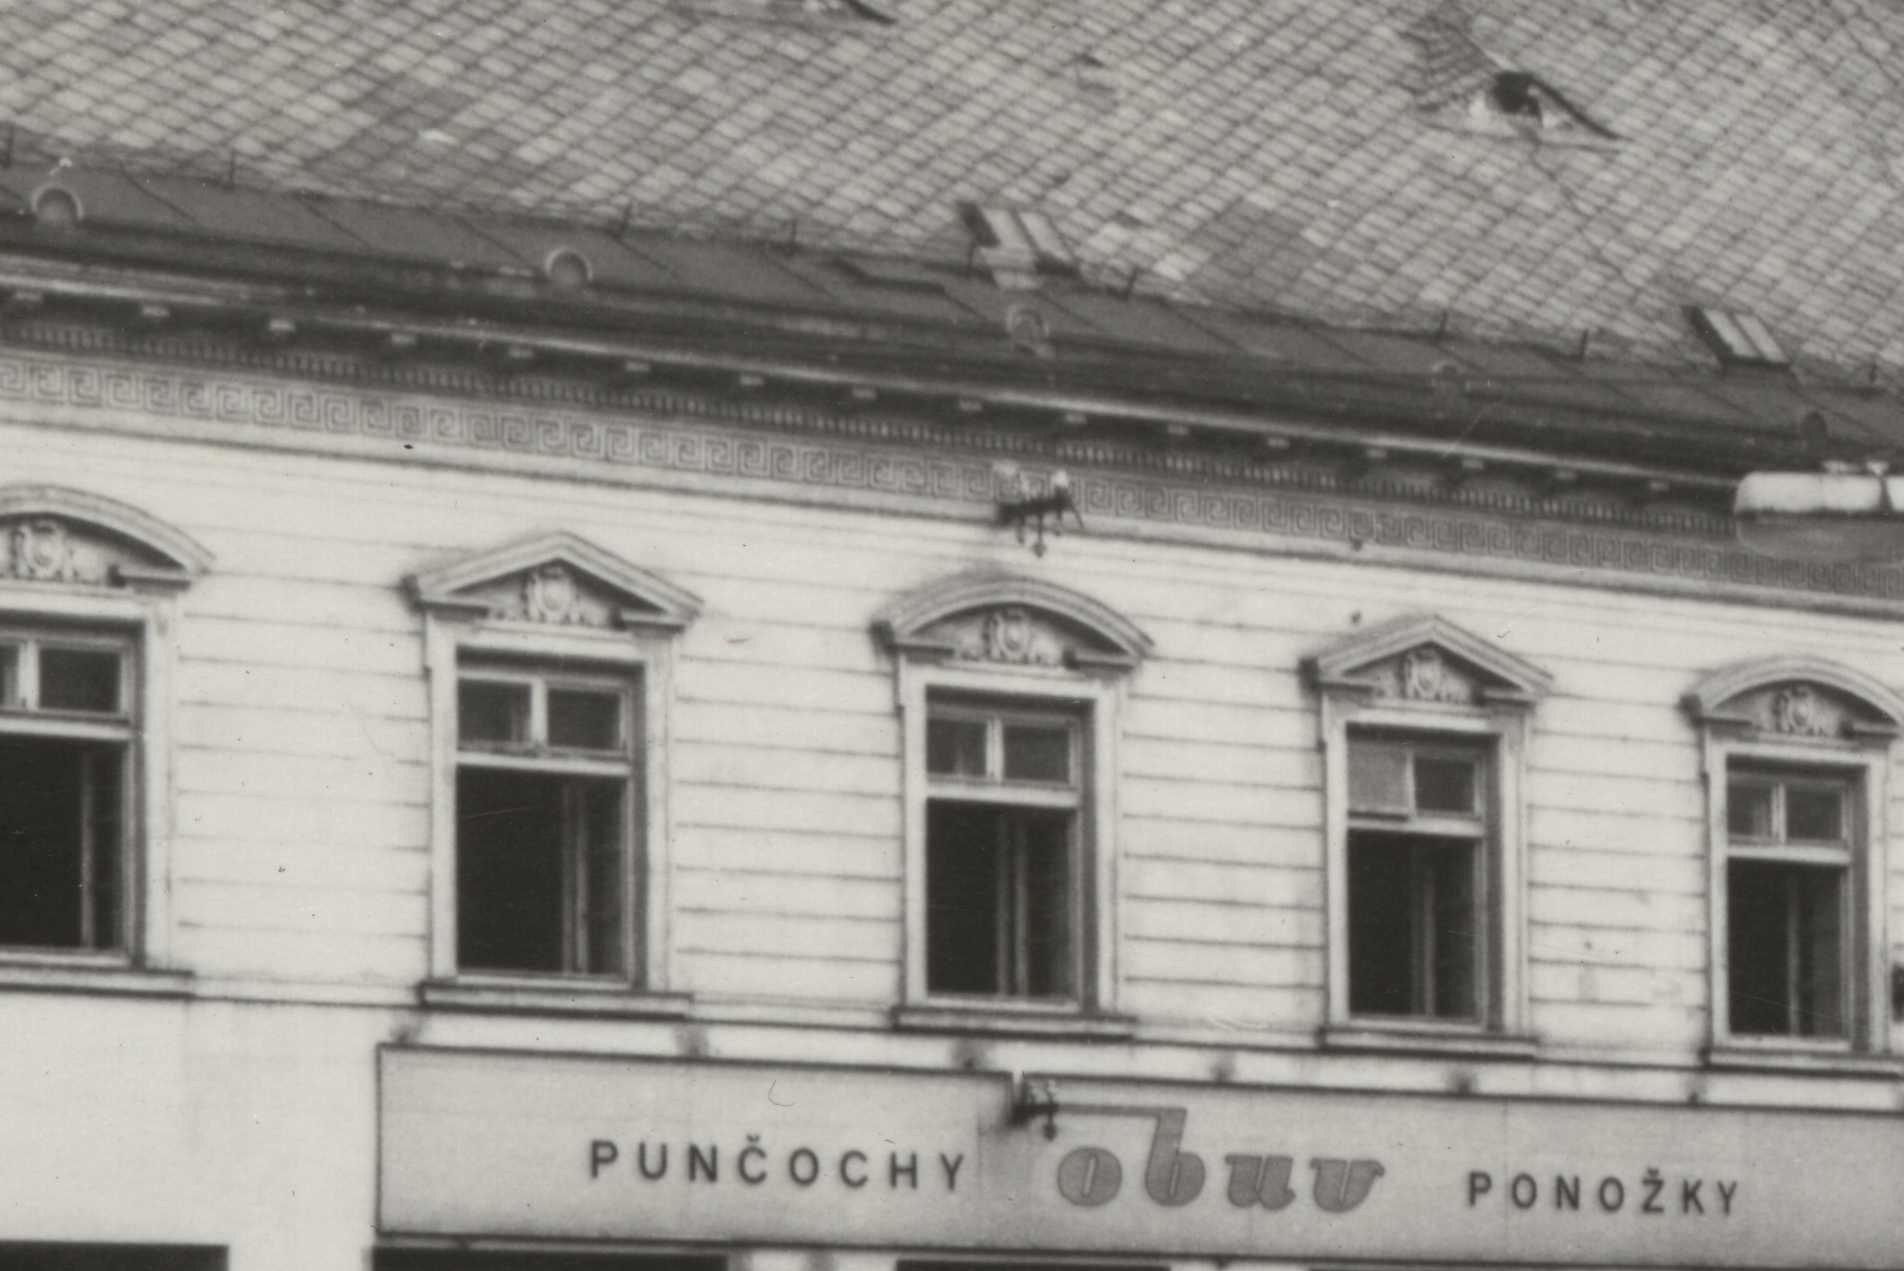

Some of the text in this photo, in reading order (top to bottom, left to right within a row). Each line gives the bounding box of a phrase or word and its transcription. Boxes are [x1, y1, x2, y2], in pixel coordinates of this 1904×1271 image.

[588, 1105, 1738, 1217] PUNČOCHY obuv PONOŽKY
